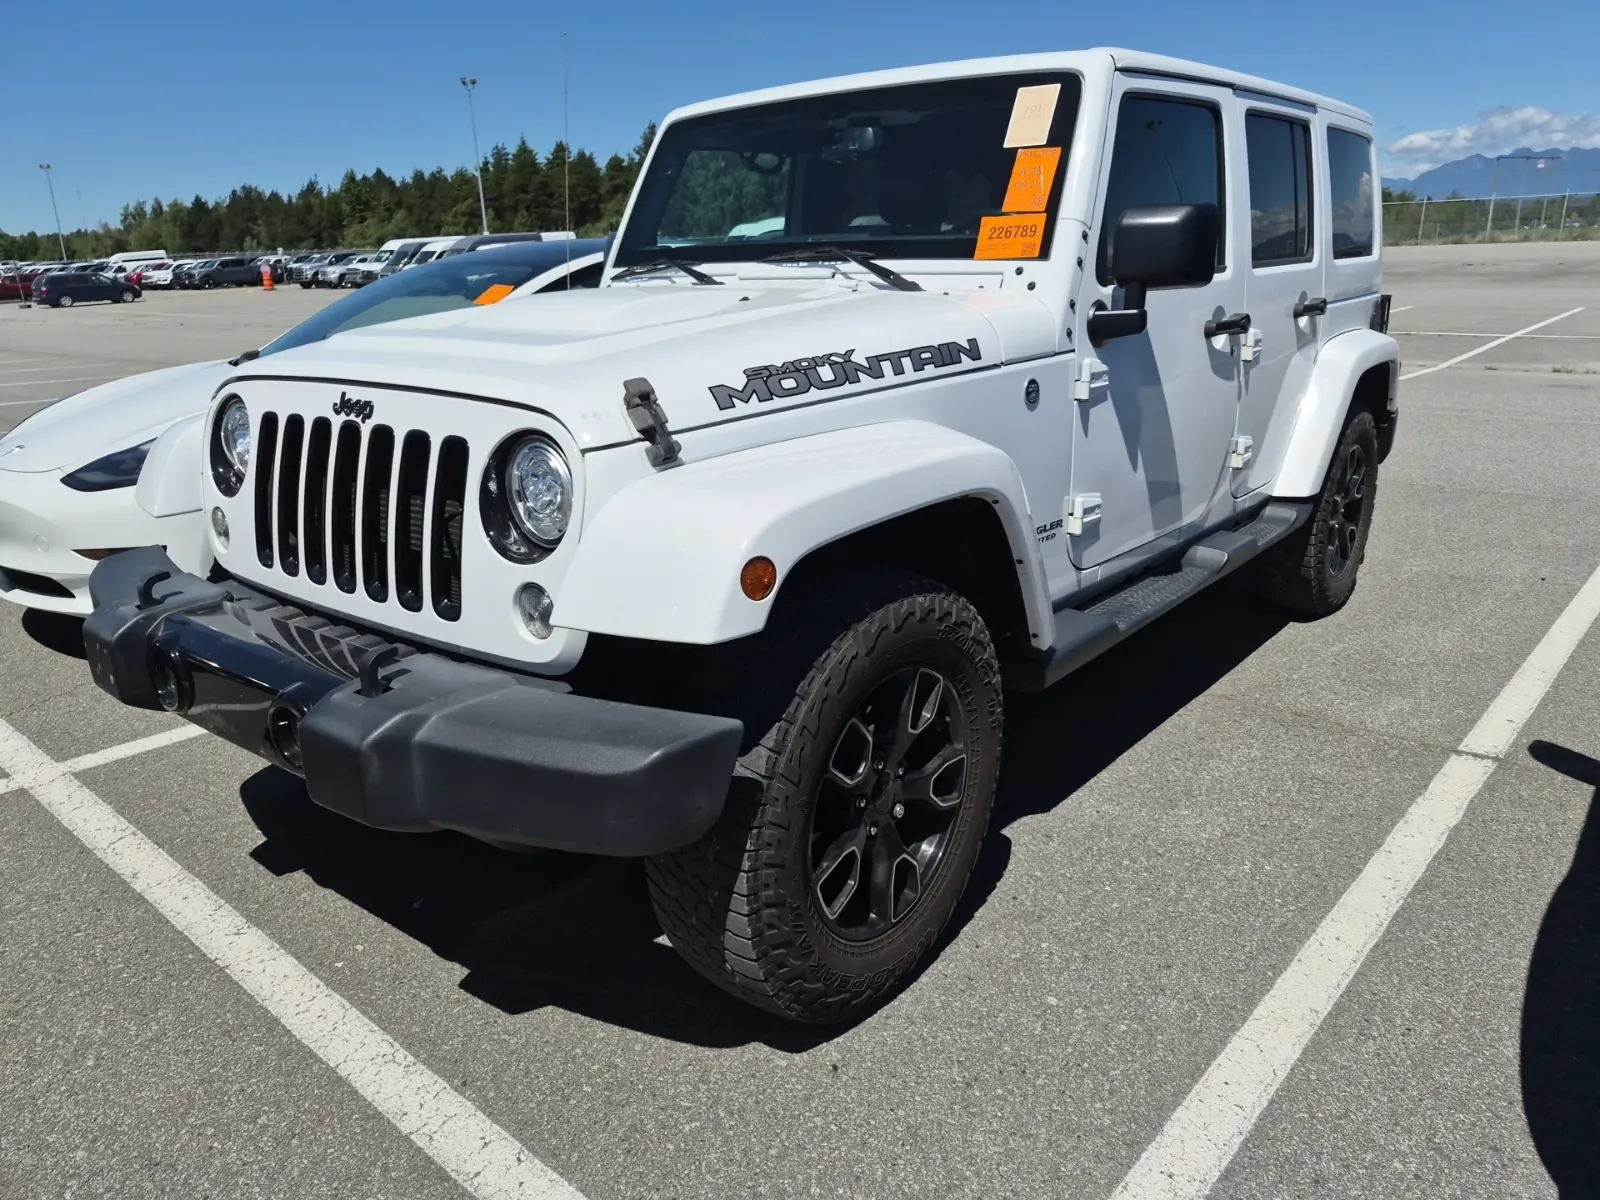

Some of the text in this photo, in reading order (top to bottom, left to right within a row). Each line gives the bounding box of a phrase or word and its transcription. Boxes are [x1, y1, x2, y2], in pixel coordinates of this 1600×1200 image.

[988, 224, 1037, 240] 226789
[708, 337, 982, 411] MOUNTAIN
[743, 348, 856, 380] SMOKY
[333, 391, 374, 424] Jeep
